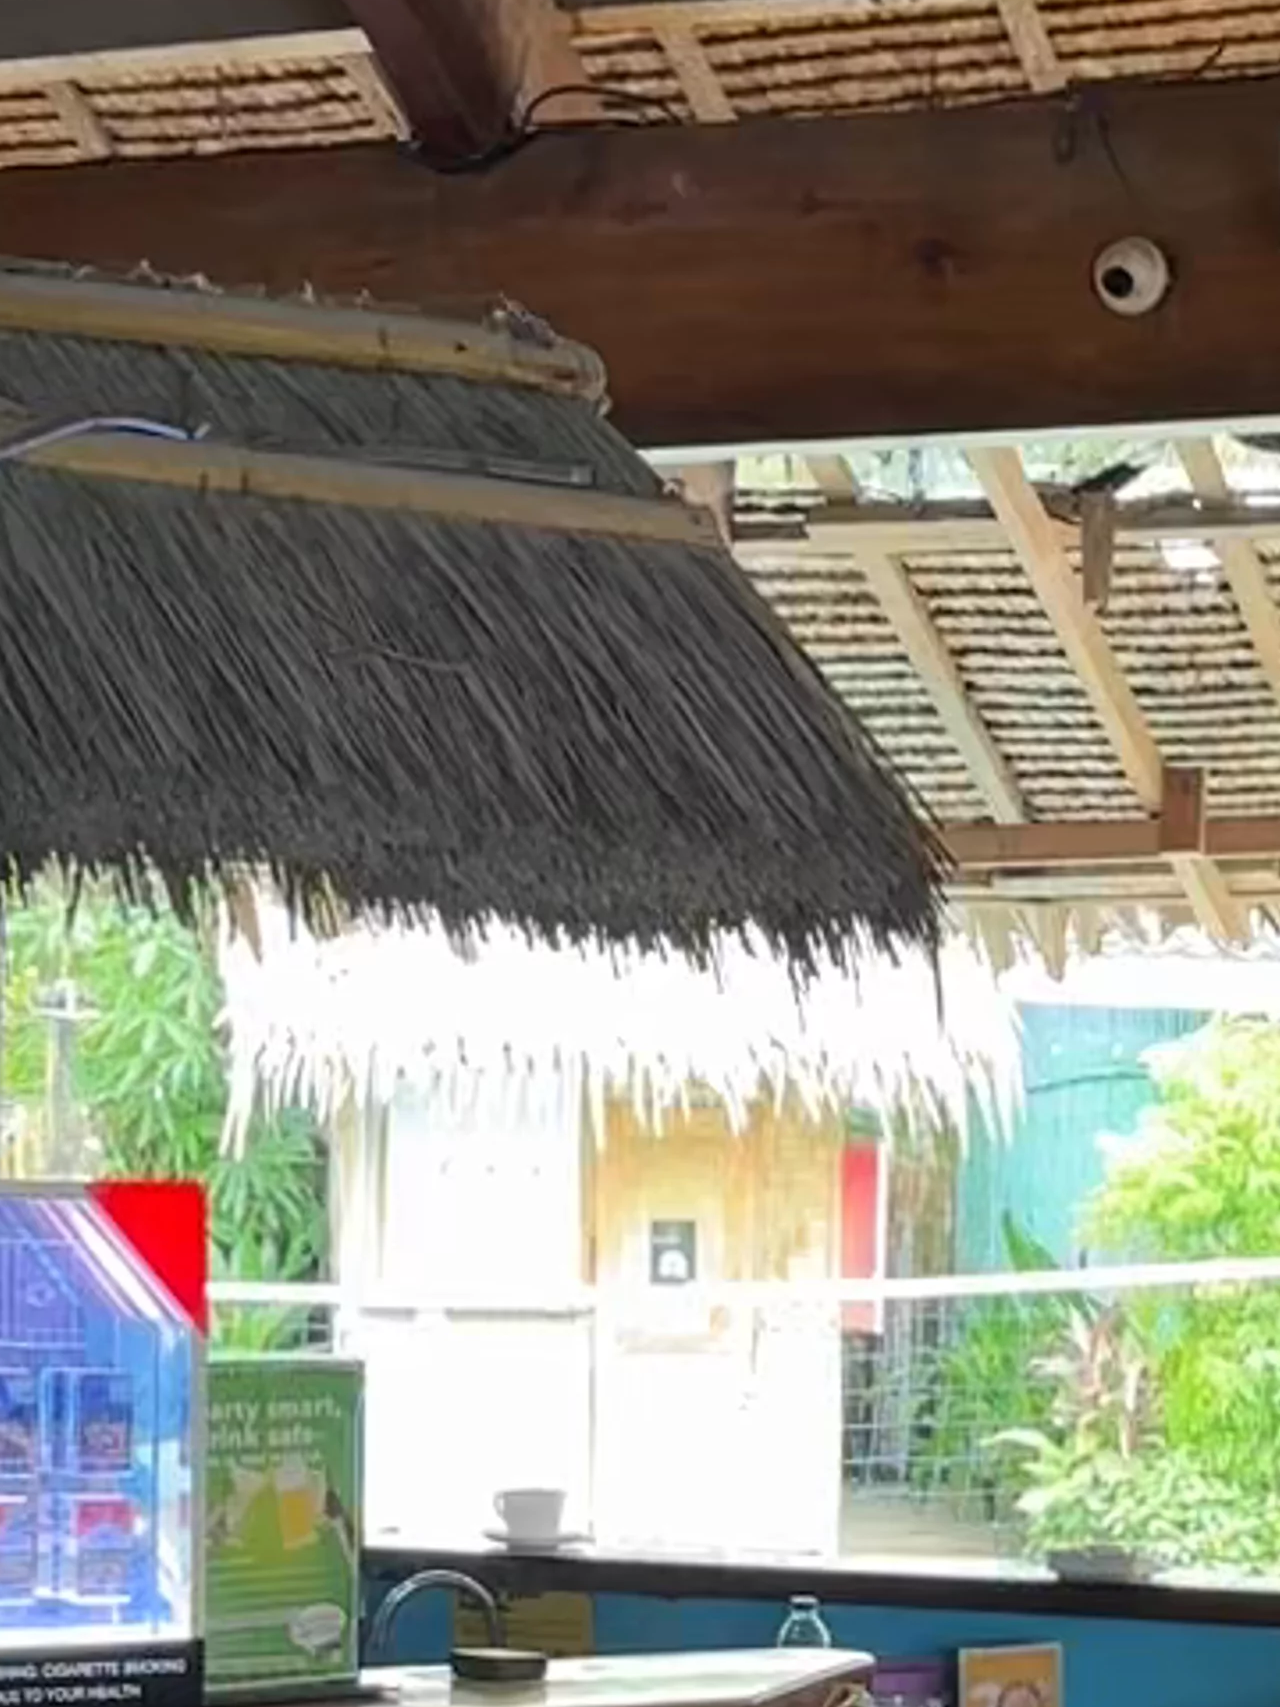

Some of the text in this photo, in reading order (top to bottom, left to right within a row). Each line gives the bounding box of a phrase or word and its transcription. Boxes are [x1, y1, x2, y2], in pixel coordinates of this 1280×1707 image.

[40, 1660, 119, 1680] CIGARETTE
[22, 1686, 43, 1704] TO
[45, 1685, 86, 1704] YOUR
[86, 1681, 143, 1702] HEALTH
